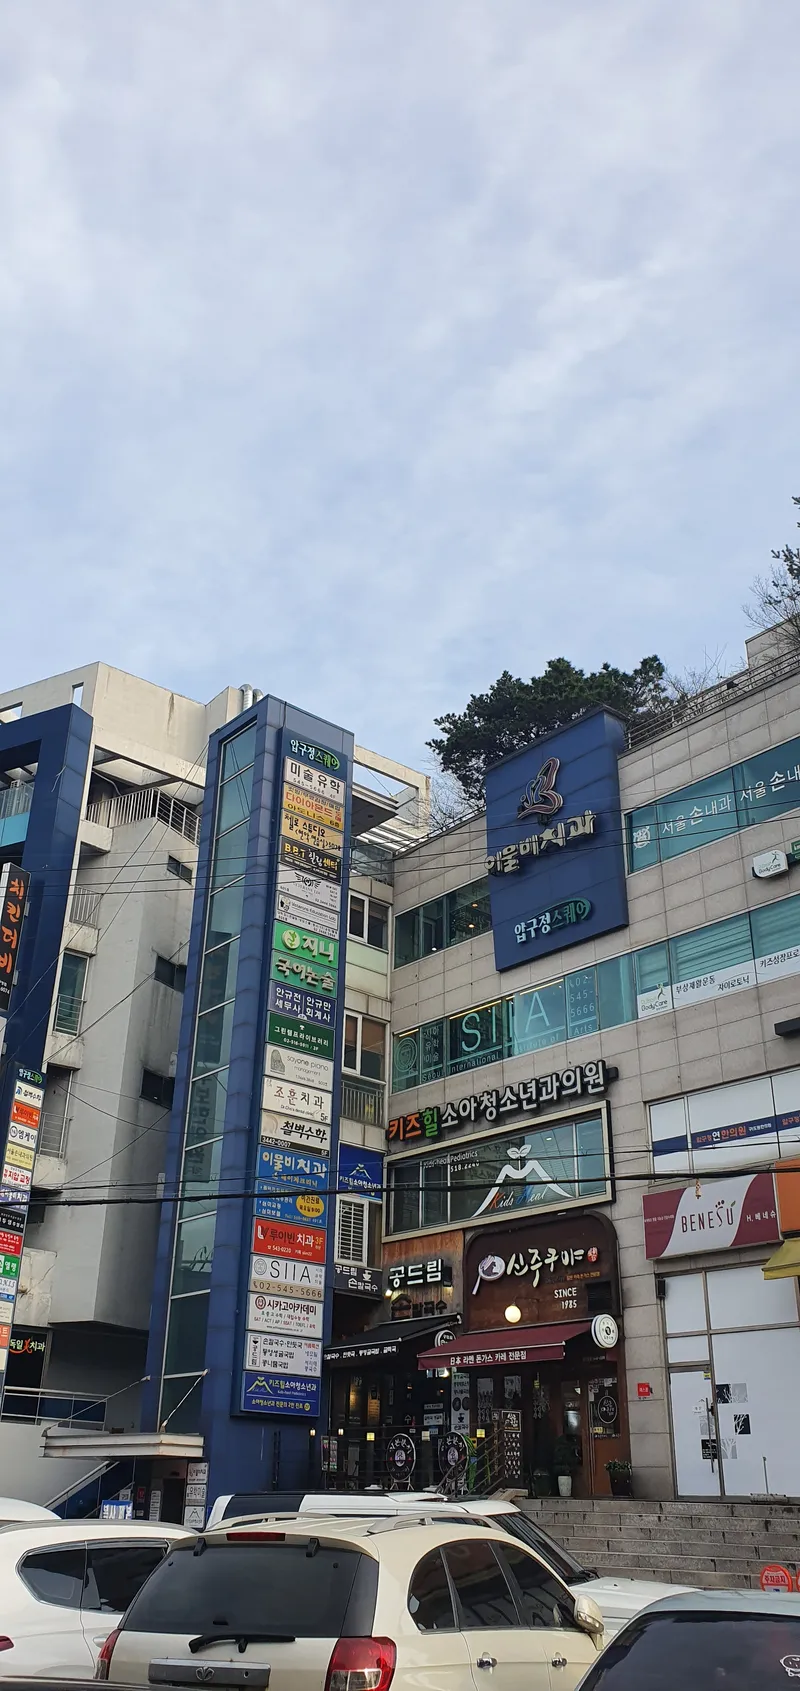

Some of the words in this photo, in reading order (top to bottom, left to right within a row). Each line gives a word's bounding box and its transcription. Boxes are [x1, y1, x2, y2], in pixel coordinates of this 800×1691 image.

[290, 739, 340, 770] 압구정스퀘어
[290, 762, 341, 794] 미술유학
[285, 792, 333, 817] 다이아몬드
[284, 842, 306, 858] B.B.T
[514, 899, 591, 943] 압구정스퀘어
[302, 934, 335, 963] 지니
[275, 956, 336, 991] 국어논술
[276, 987, 301, 1003] 안규전
[275, 998, 301, 1013] 세무사
[306, 996, 332, 1011] 안규만
[570, 1002, 595, 1017] 5666
[641, 999, 668, 1012] BodyCare
[306, 1007, 331, 1023] 회계사
[573, 1023, 592, 1035] Arts
[310, 1062, 329, 1072] piano
[273, 1085, 325, 1110] 조훈치과
[388, 1059, 606, 1142] 키즈힐소아청소년과의원
[320, 1112, 328, 1122] 5F
[281, 1121, 328, 1144] 철벽수학
[262, 1136, 291, 1148] 3442-0007
[450, 1149, 478, 1164] Pediatrics
[489, 1191, 514, 1210] Kids
[315, 1236, 323, 1245] 3F
[269, 1260, 311, 1283] SIIA
[335, 1264, 358, 1276] 공드림
[389, 1258, 442, 1288] 공드림
[259, 1282, 322, 1298] 02-545-5666
[348, 1277, 379, 1292] 손칼국수
[554, 1287, 578, 1299] SINCE
[267, 1299, 317, 1316] 시카고아카데미
[561, 1299, 578, 1310] 1985
[450, 1356, 461, 1366] 日本
[476, 1354, 493, 1363] 돈가스
[495, 1352, 507, 1362] 카레
[508, 1350, 527, 1361] 전문점
[269, 1379, 317, 1392] 키즈힐소아청소년과
[764, 1574, 786, 1584] 주차금지
